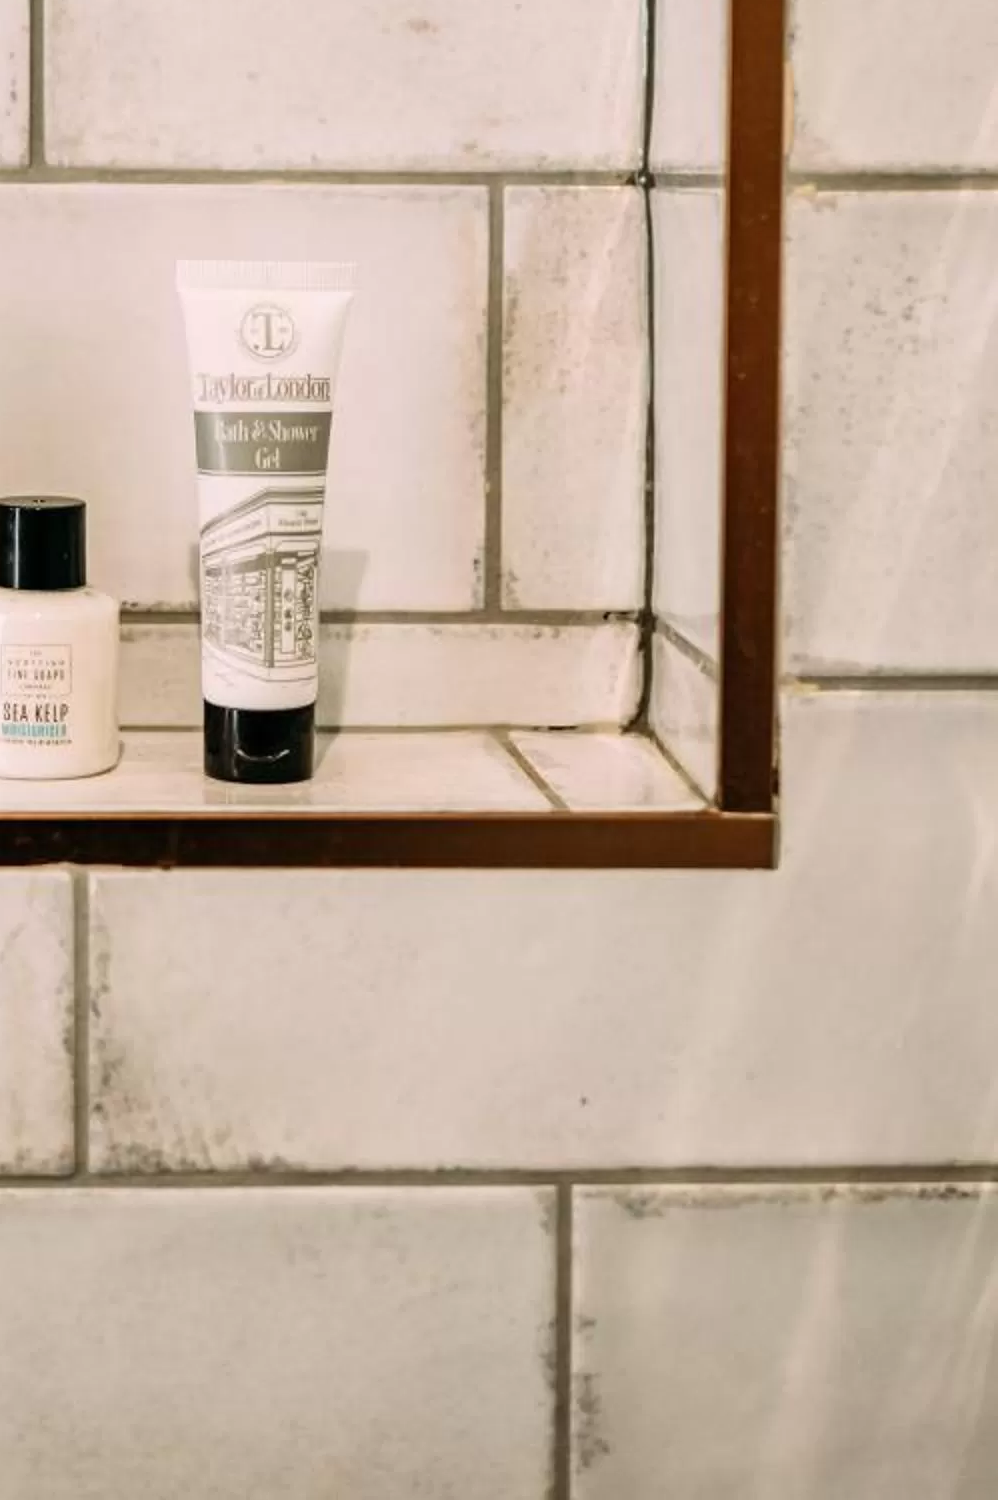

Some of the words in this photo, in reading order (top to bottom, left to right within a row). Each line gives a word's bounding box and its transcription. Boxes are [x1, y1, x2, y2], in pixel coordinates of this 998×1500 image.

[198, 372, 253, 404] Taylor
[264, 372, 331, 402] London
[214, 419, 249, 443] Bath
[268, 419, 319, 443] Shower
[254, 447, 281, 469] Gel
[3, 702, 29, 722] SEA
[35, 703, 70, 723] KELP
